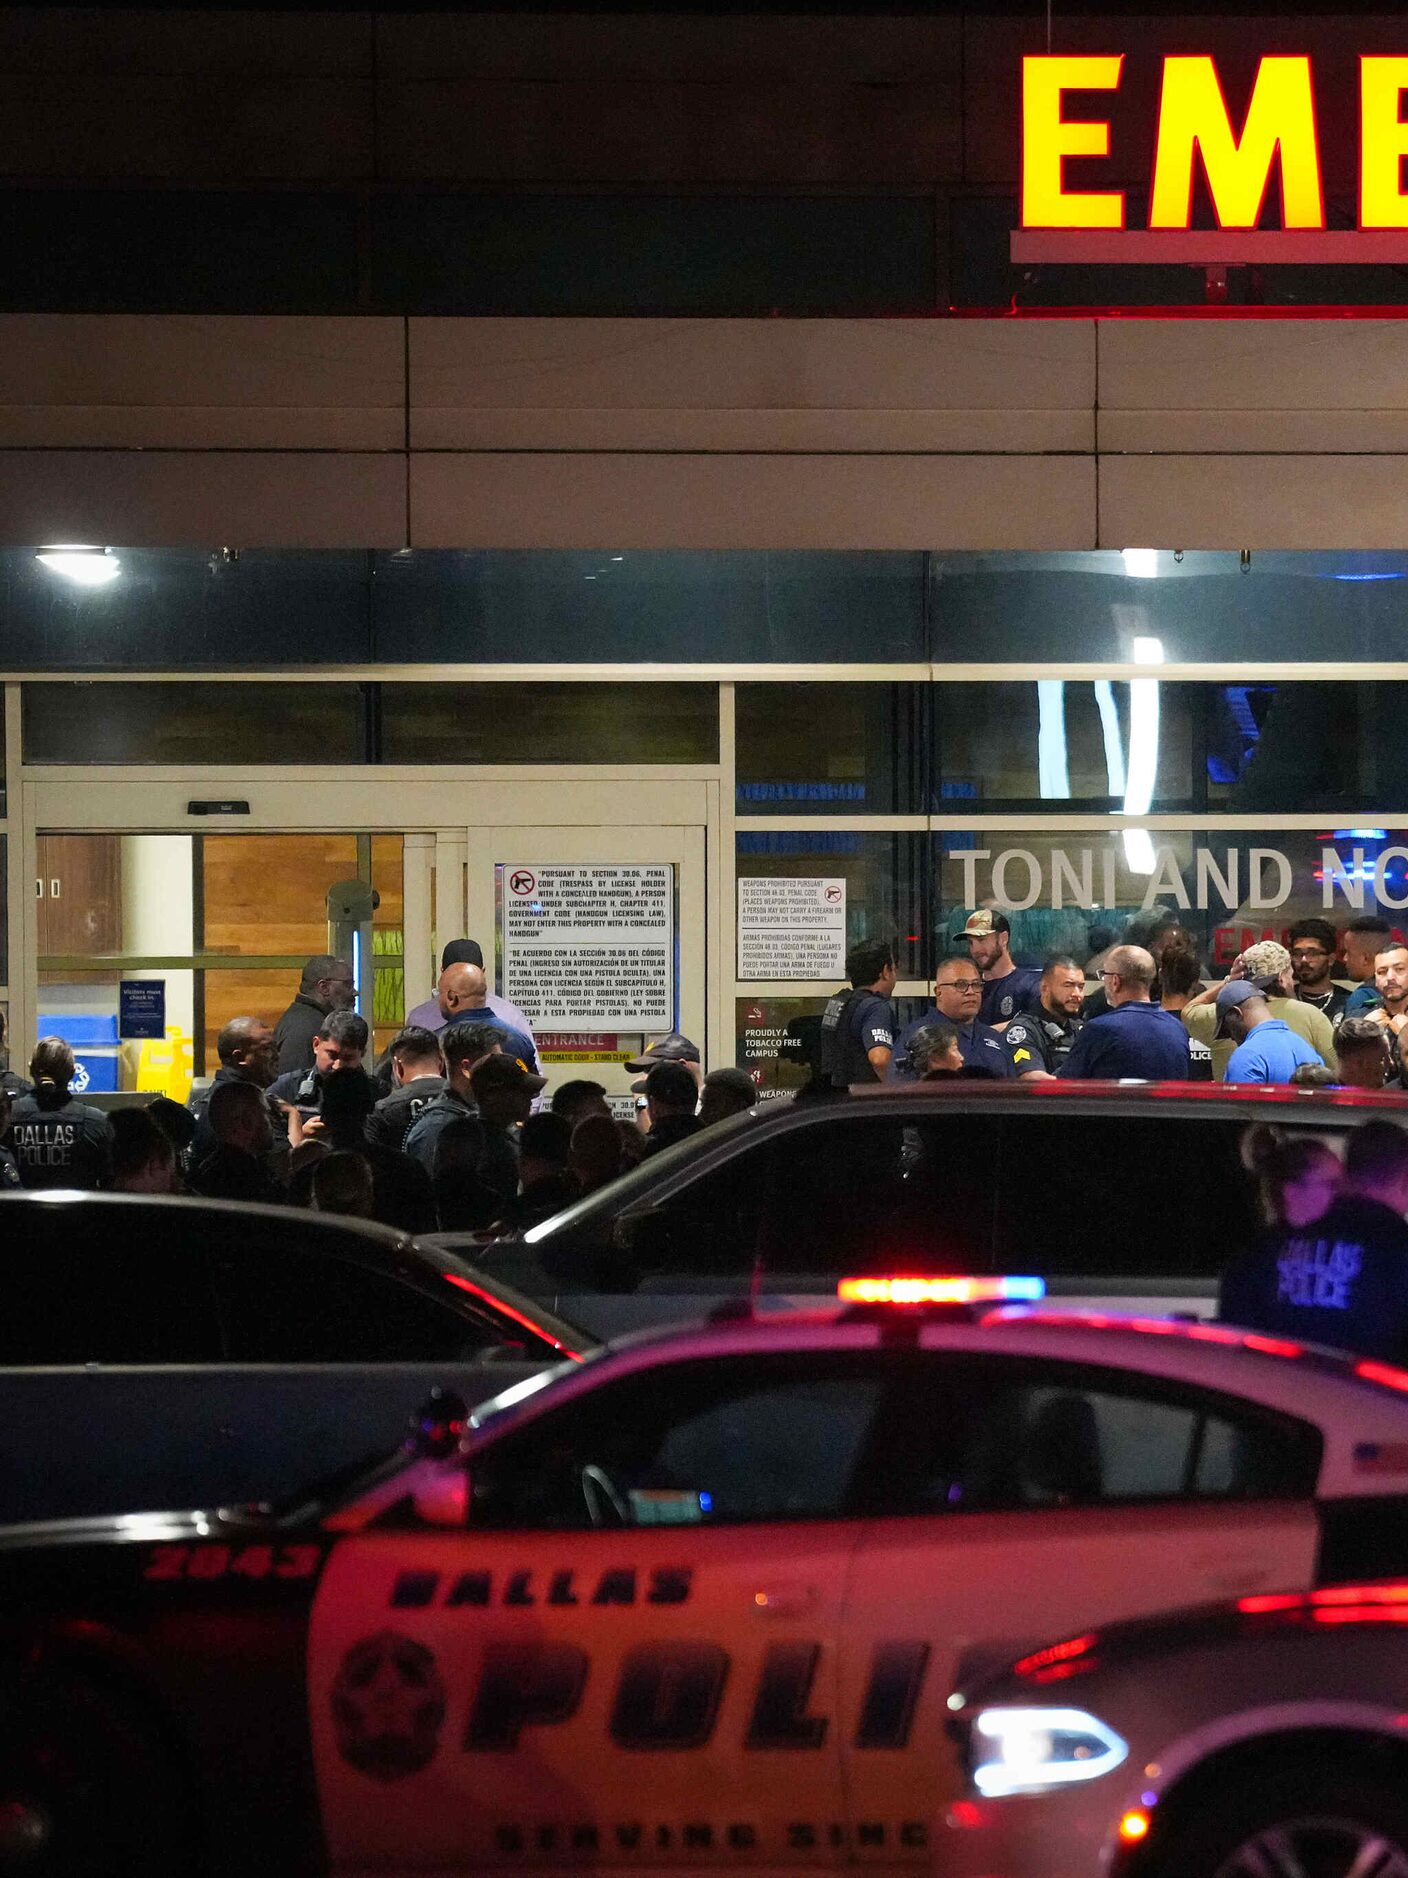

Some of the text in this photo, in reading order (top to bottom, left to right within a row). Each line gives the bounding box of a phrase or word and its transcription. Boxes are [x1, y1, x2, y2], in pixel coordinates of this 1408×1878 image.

[579, 870, 588, 878] TO
[592, 870, 618, 878] SECTION
[646, 870, 665, 878] PENAL
[949, 848, 1116, 911] TONI
[1141, 848, 1293, 910] AND
[538, 880, 666, 888] CODE (TRESPASS BY LICENSE HOLDER
[538, 890, 554, 898] WITH
[555, 890, 560, 898] A
[561, 890, 598, 898] CONCEALED
[635, 890, 640, 898] A
[640, 890, 666, 898] PERSON
[541, 900, 563, 908] UNDER
[566, 900, 607, 908] SUBCHAPTER
[620, 900, 649, 908] CHAPTER
[508, 910, 550, 918] GOVERNMENT
[554, 910, 571, 918] CODE
[575, 910, 608, 918] (HANDGUN
[612, 910, 645, 918] LICENSING
[508, 920, 666, 928] MAY NOT ENTER THIS PROPERTY WITH A CONCEALED
[522, 949, 553, 957] ACUERDO
[554, 949, 568, 957] CON
[569, 949, 577, 957] LA
[628, 949, 639, 957] DEL
[508, 959, 528, 967] PENAL
[530, 959, 560, 967] (INGRESO
[561, 959, 572, 967] SIN
[620, 959, 629, 967] DE
[630, 959, 639, 967] UN
[640, 959, 666, 967] TITULAR
[508, 969, 517, 977] DE
[518, 969, 532, 977] UNA
[534, 969, 563, 977] LICENCIA
[564, 969, 578, 977] CON
[579, 969, 593, 977] UNA
[594, 969, 621, 977] PISTOLA
[652, 969, 666, 977] UNA
[508, 979, 538, 987] PERSONA
[539, 979, 553, 987] CON
[554, 979, 583, 987] LICENCIA
[606, 979, 612, 987] EL
[583, 989, 594, 997] DEL
[596, 989, 629, 997] GOBIERNO
[630, 989, 643, 997] (LEY
[645, 989, 666, 997] SOBRE
[512, 999, 541, 1007] ICENCIAS
[544, 999, 562, 1007] PARA
[566, 999, 592, 1007] PORTAR
[633, 999, 643, 1007] NO
[646, 999, 666, 1007] PUEDE
[544, 1009, 549, 1017] A
[550, 1009, 567, 1017] ESTA
[569, 1009, 606, 1017] PROPIEDAD
[608, 1009, 622, 1017] CON
[624, 1009, 638, 1017] UNA
[640, 1009, 667, 1017] PISTOLA
[14, 1125, 74, 1145] DALLAS
[18, 1146, 70, 1166] POLICE
[390, 1567, 692, 1608] DALLAS
[498, 1822, 930, 1852] SERVING SINC
